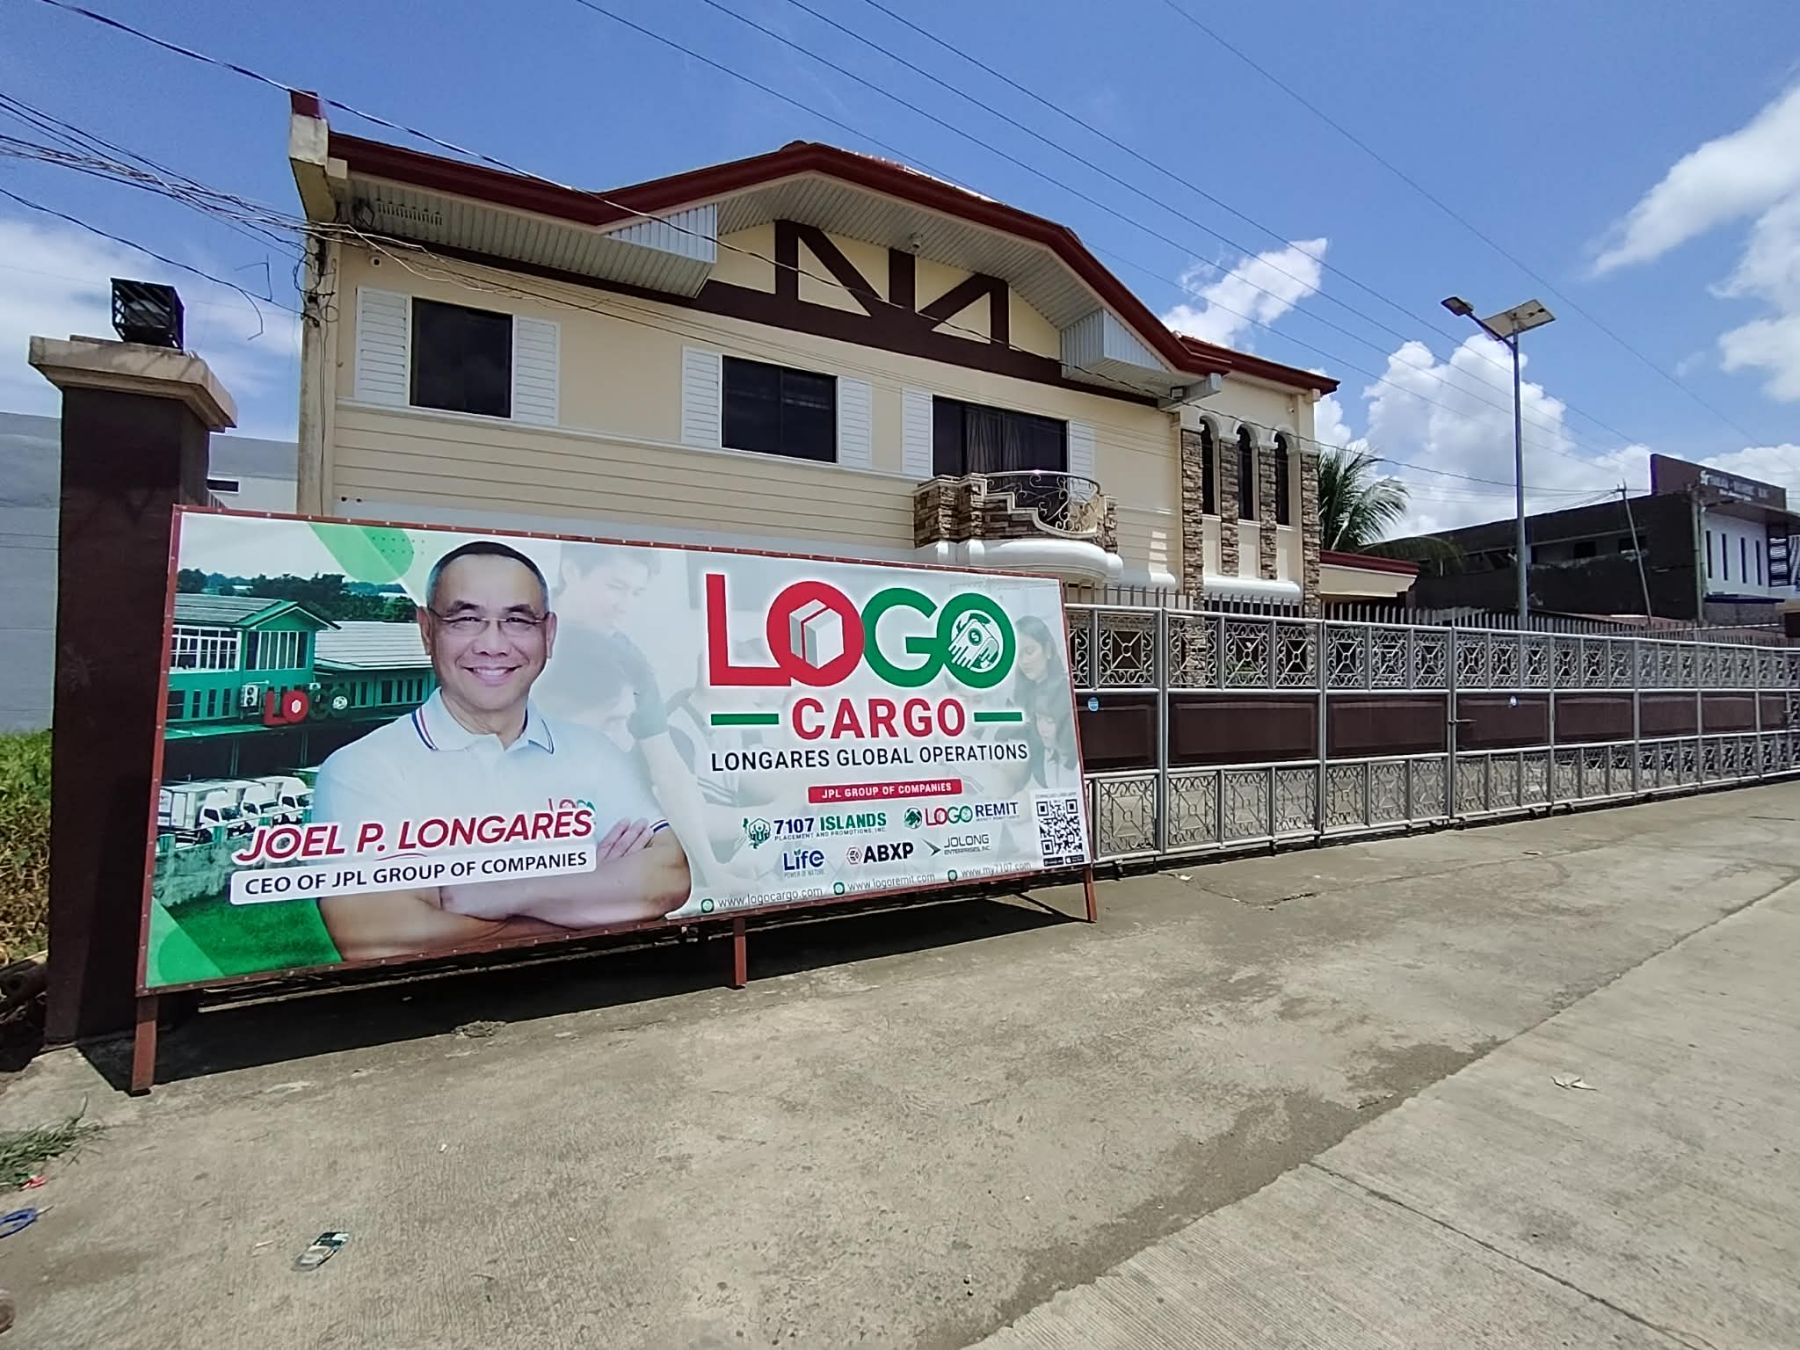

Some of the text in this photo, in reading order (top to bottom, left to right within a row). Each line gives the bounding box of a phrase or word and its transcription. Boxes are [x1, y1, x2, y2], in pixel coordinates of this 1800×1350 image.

[705, 573, 1017, 689] LOGO
[792, 697, 966, 741] CARGO
[710, 743, 1029, 772] LONGARES GLOBAL OPERATIONS
[821, 781, 953, 800] JPL GROUP OF COMPANIES
[774, 812, 887, 835] 7107 ISLANDS
[925, 805, 973, 826] LOGO
[975, 802, 1019, 817] REMIT
[236, 810, 594, 865] JOEL P. LONGARES
[774, 832, 814, 841] PLACEMENT
[816, 830, 829, 838] AND
[943, 833, 990, 849] JOLONG
[783, 849, 825, 871] Life
[863, 842, 915, 865] ABXP
[245, 852, 589, 896] CEO OF JPL GROUP OF COMPANIES
[960, 861, 1032, 877] www.my7107.com
[847, 871, 936, 892] www.logoremit.com
[718, 886, 824, 908] www.logocargo.com
